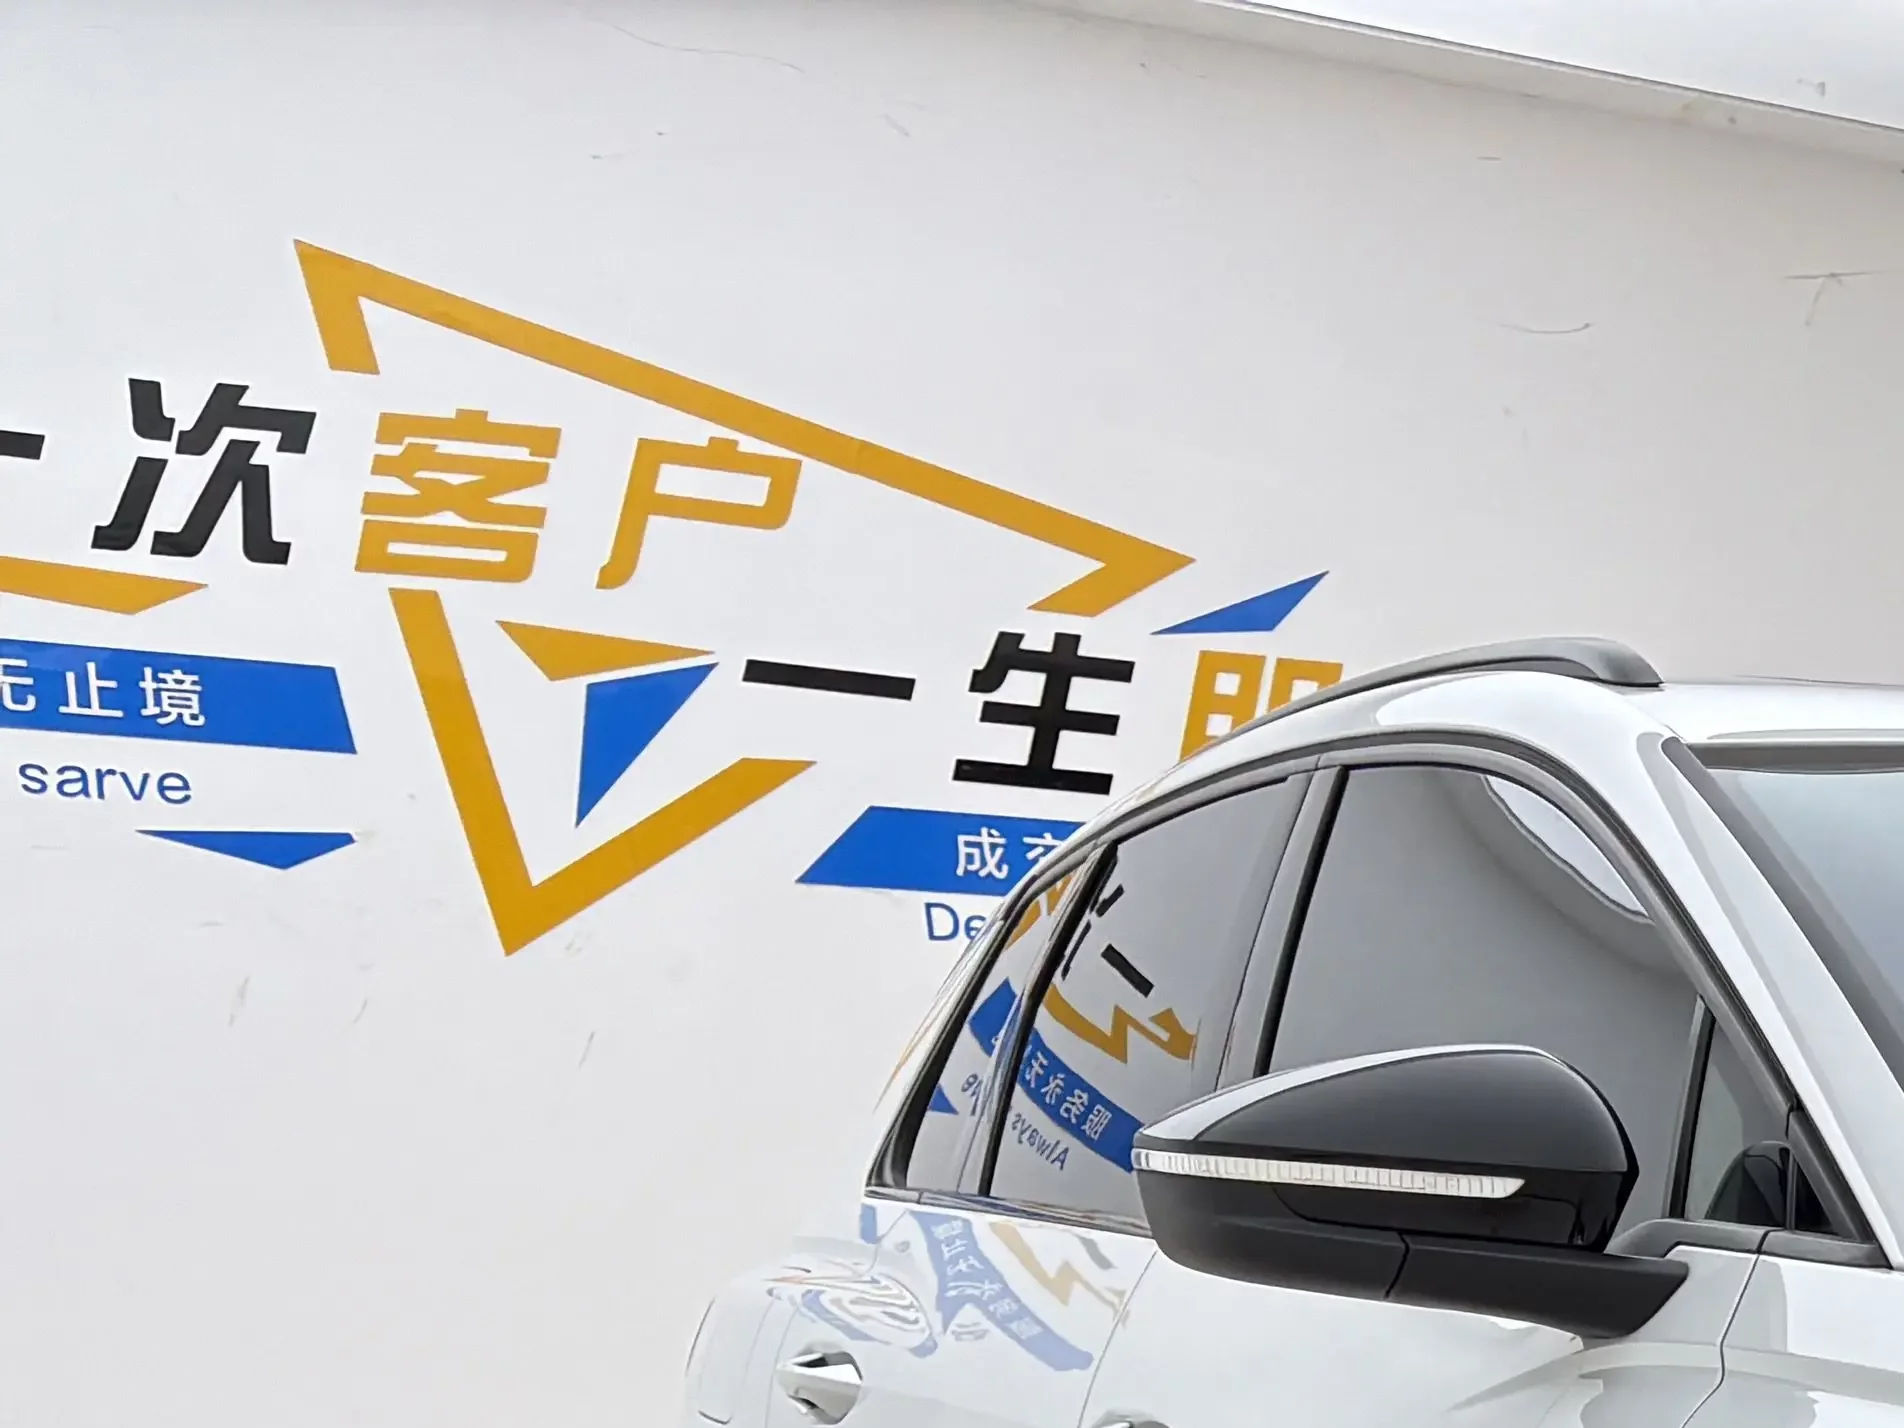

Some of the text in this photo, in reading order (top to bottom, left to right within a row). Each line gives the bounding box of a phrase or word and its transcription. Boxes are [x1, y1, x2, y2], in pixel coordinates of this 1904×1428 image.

[0, 378, 803, 590] 次客户
[18, 762, 193, 805] sarve
